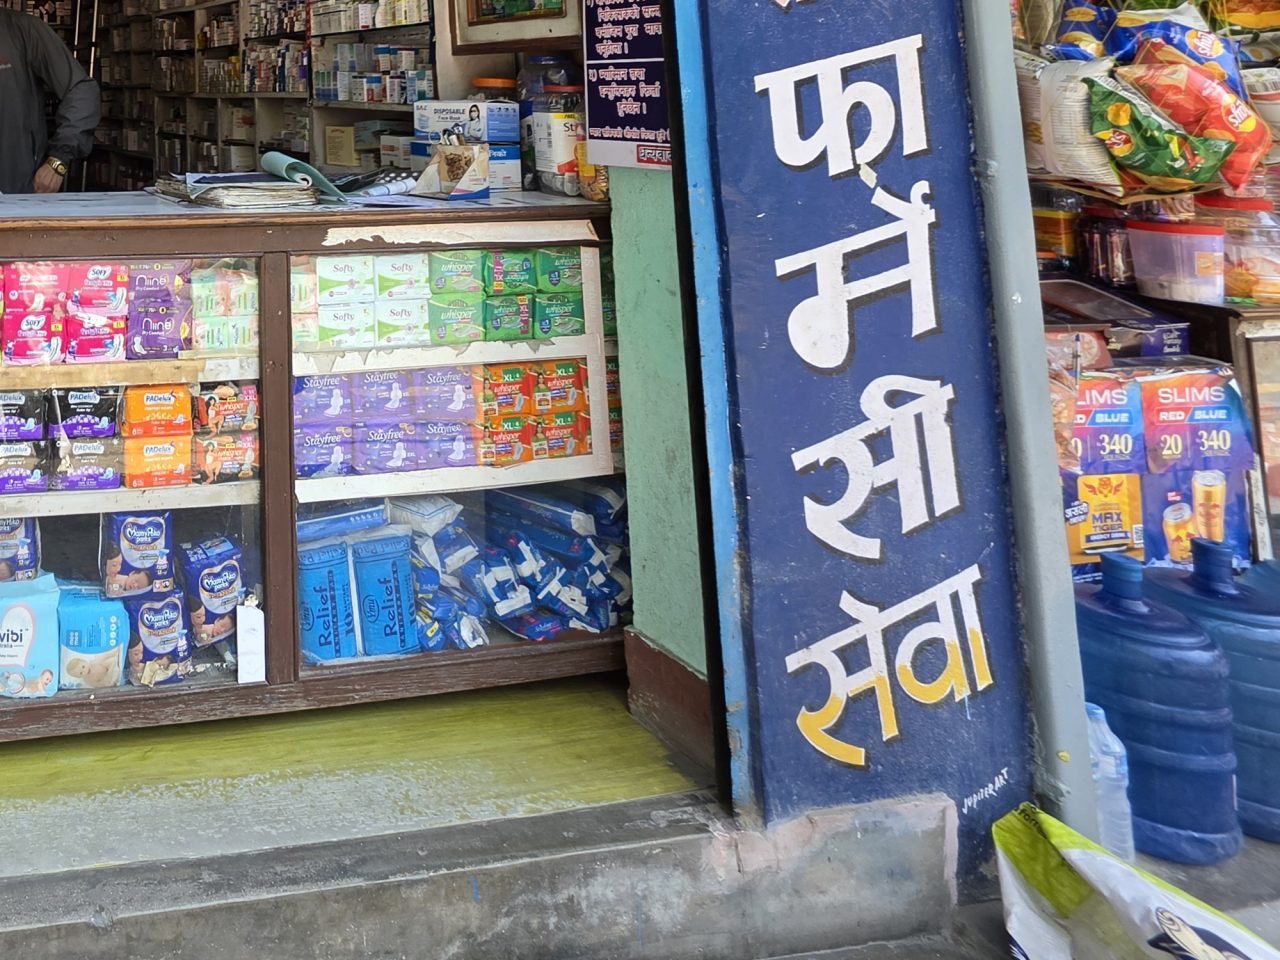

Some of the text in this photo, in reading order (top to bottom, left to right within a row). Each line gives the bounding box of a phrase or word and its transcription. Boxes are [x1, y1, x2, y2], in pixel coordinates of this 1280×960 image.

[434, 107, 466, 115] DISPOSABLE
[333, 264, 355, 273] Softy
[390, 262, 414, 272] Softy
[333, 312, 355, 321] Softy
[389, 308, 412, 318] Softy
[426, 372, 461, 386] Stayfree
[504, 374, 514, 382] XL
[556, 368, 567, 376] XL
[303, 375, 340, 390] Stayfree
[1158, 387, 1225, 404] SLIMS
[1095, 411, 1130, 423] BLUE
[1159, 408, 1227, 422] RED BLUE
[503, 422, 513, 430] XL
[304, 432, 342, 448] Stayfree
[367, 428, 405, 443] Stayfree
[1161, 429, 1232, 455] 20 340
[1099, 432, 1133, 455] 340
[1092, 512, 1123, 524] MAX
[1093, 524, 1123, 532] TIGER
[377, 577, 398, 638] Relief
[313, 585, 333, 647] Relief
[785, 564, 993, 766] सेवा
[962, 783, 997, 815] JUPITER
